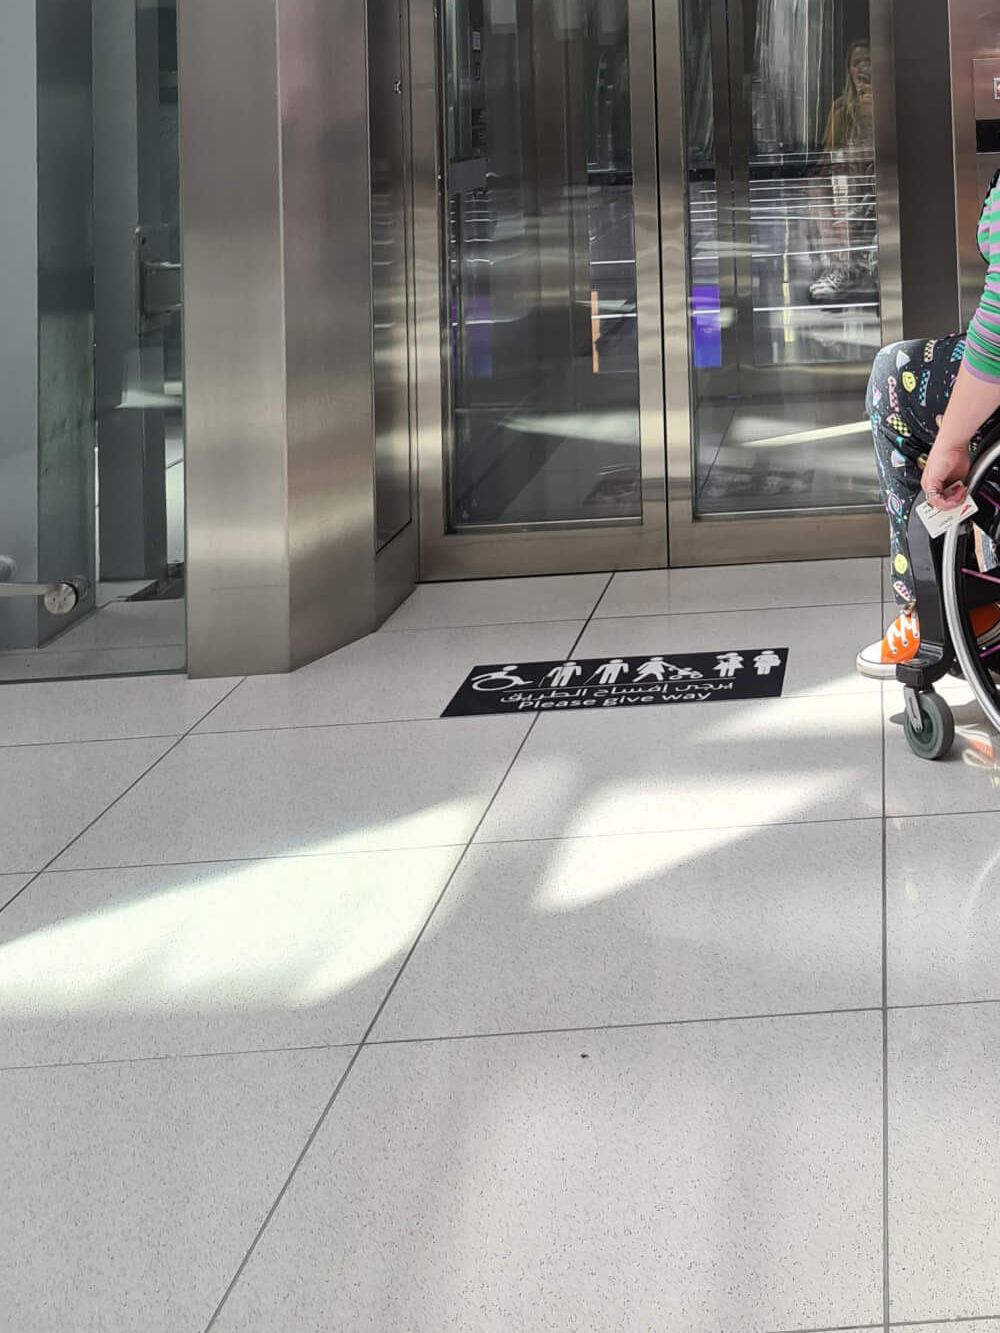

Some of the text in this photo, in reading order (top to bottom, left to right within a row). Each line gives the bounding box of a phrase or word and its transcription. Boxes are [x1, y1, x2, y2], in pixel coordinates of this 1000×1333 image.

[500, 687, 588, 703] الطريق
[517, 690, 713, 710] Please give way
